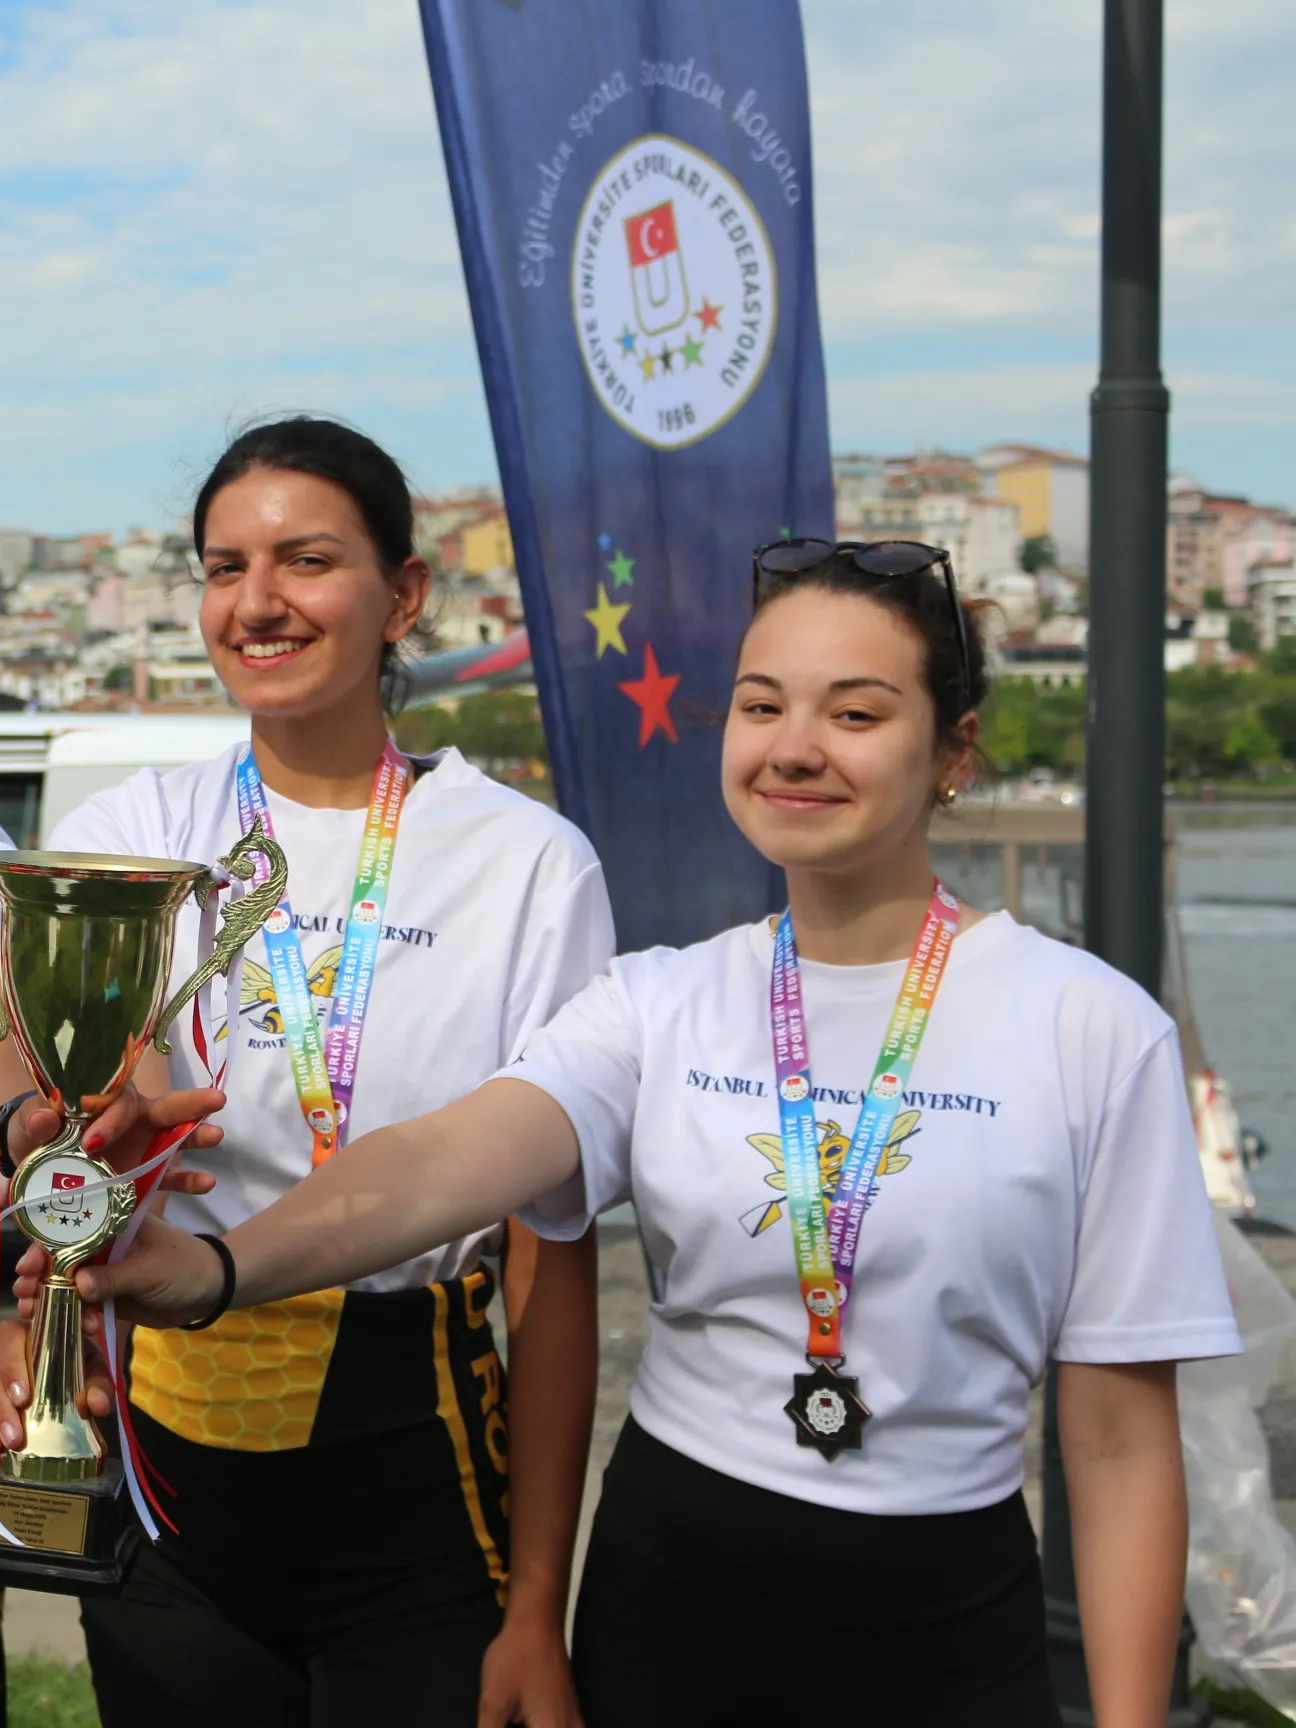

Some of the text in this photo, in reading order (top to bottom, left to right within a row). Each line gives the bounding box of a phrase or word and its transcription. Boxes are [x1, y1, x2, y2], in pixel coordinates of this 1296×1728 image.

[568, 68, 632, 140] spora
[709, 192, 762, 388] FEDERASYONU
[238, 777, 251, 832] NIVERSITY
[360, 758, 392, 884] TURKISH UNIVERSITY
[375, 768, 405, 887] SPORTS FEDERATIO
[336, 938, 361, 1016] ÜNİVERSİTE
[341, 939, 374, 1086] SPORLARI FEDERASYONU
[784, 923, 804, 1060] SPORTS FEDERATION
[884, 911, 940, 1056] TURKISH UNIVERSITY
[305, 1029, 326, 1089] SPORLARI
[774, 1005, 789, 1064] TURKISH
[900, 1007, 927, 1061] SPORTS
[686, 1069, 768, 1098] ISTANBUL
[901, 1091, 1002, 1118] NIVERSITY
[802, 1115, 821, 1201] FEDERASYONU
[840, 1201, 864, 1267] SPORLARI
[855, 1113, 892, 1201] FEDERASYONU
[841, 1110, 877, 1191] ÜNİVERSİTE
